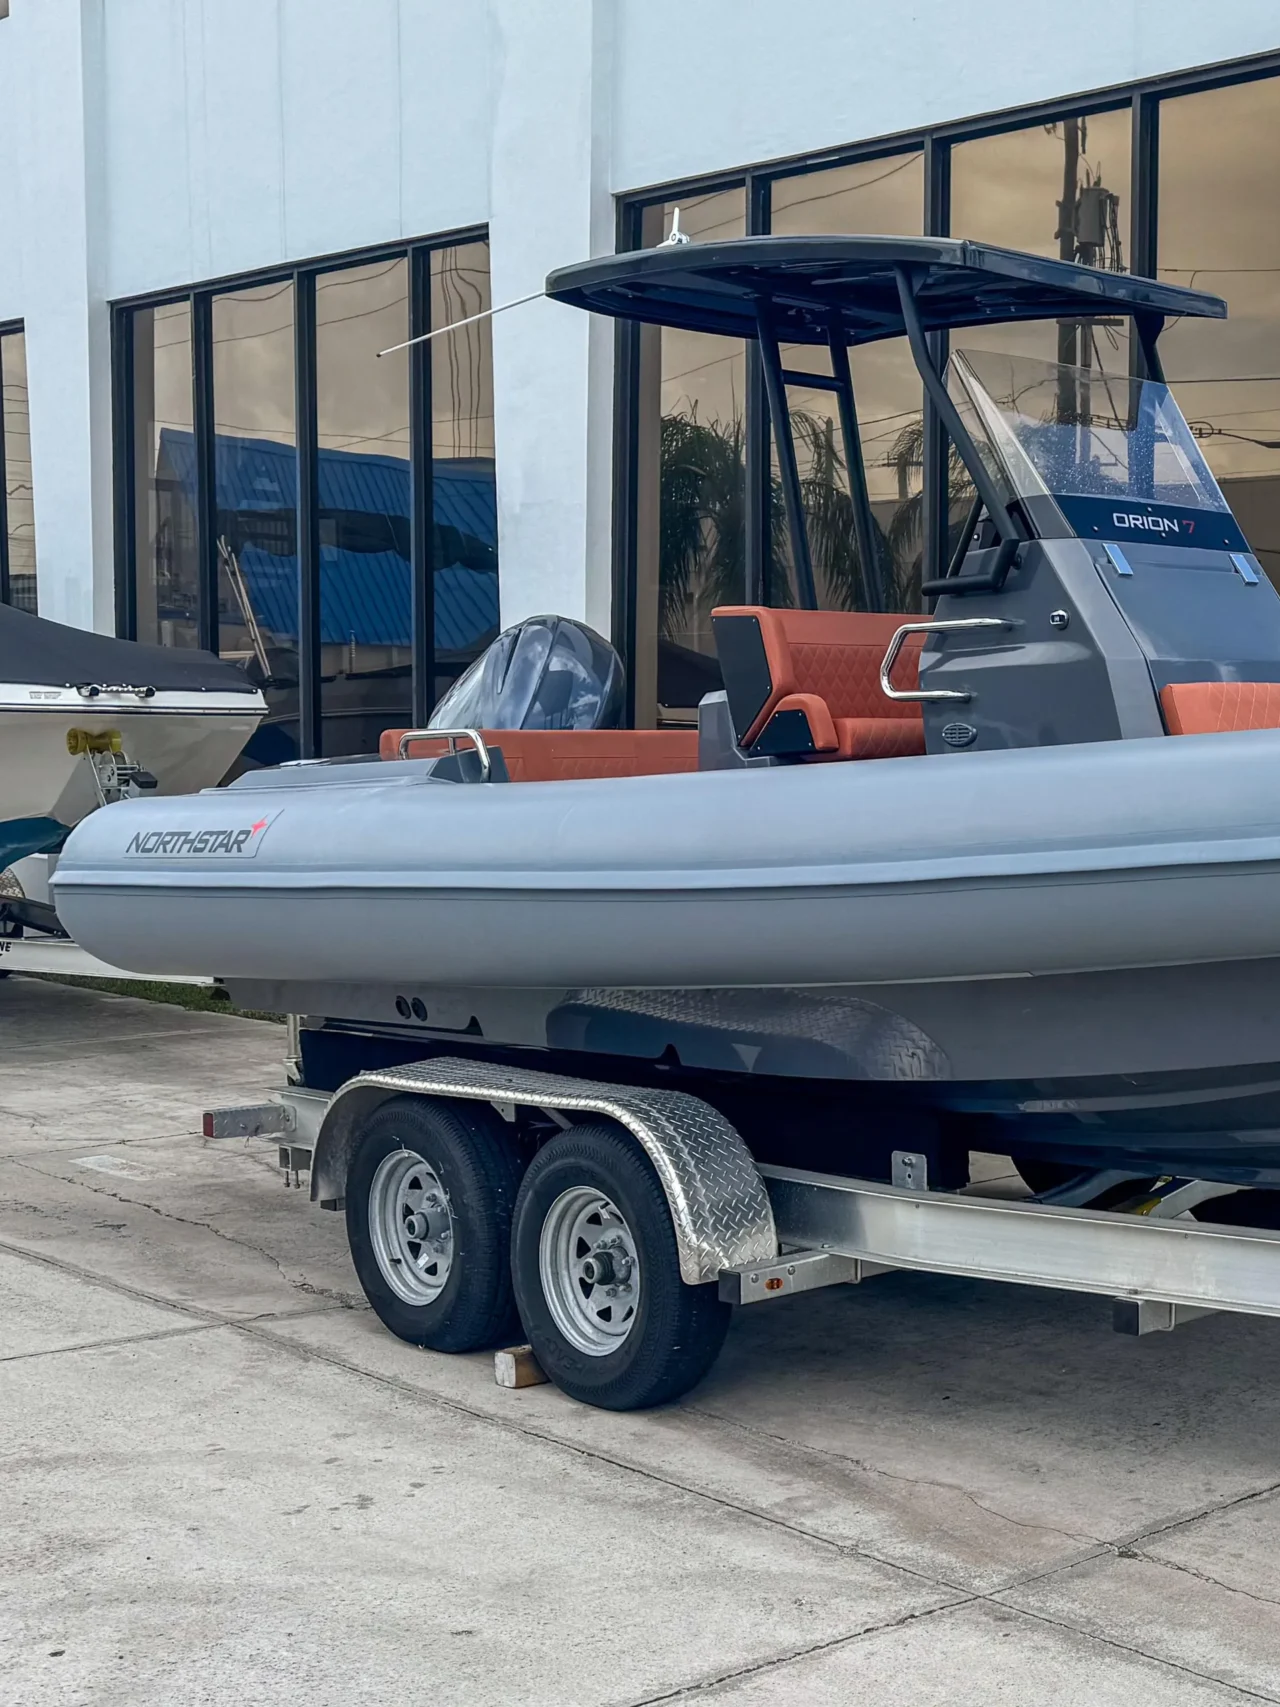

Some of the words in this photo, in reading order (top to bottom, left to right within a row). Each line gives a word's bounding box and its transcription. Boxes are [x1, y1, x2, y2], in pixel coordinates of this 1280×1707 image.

[1112, 512, 1180, 533] ORION
[1182, 519, 1196, 534] 7
[125, 829, 252, 854] NORTHSTAR
